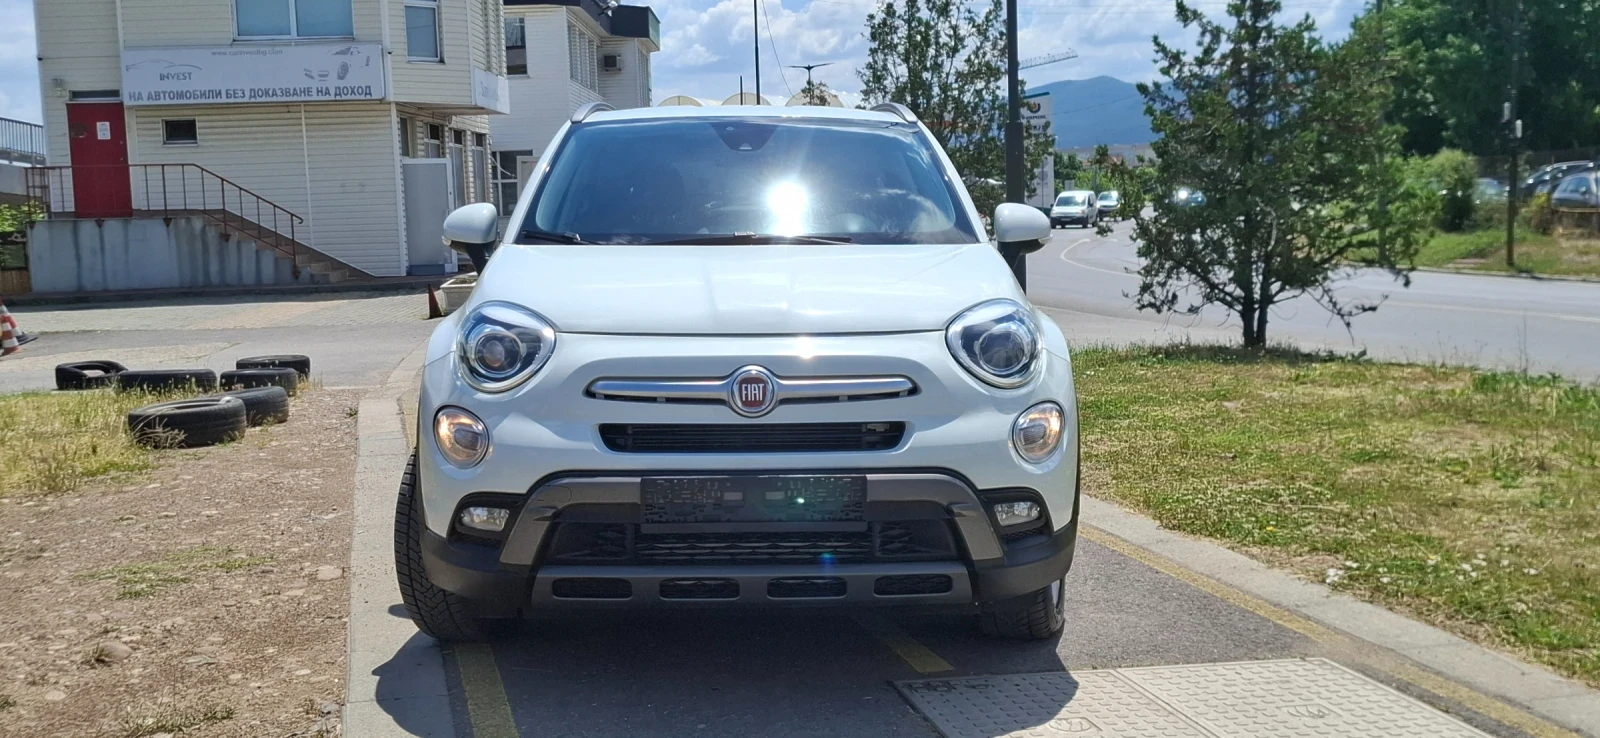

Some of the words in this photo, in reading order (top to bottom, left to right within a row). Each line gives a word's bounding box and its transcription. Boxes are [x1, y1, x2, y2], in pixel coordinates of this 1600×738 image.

[159, 71, 192, 81] INVEST
[128, 91, 145, 102] НА
[147, 89, 221, 101] АВТОМОБИЛИ
[225, 88, 246, 100] БЕЗ
[249, 86, 313, 100] ДОКАЗВАНЕ
[316, 86, 332, 97] НА
[334, 85, 373, 98] ДОХОД
[741, 383, 765, 402] FIAT
